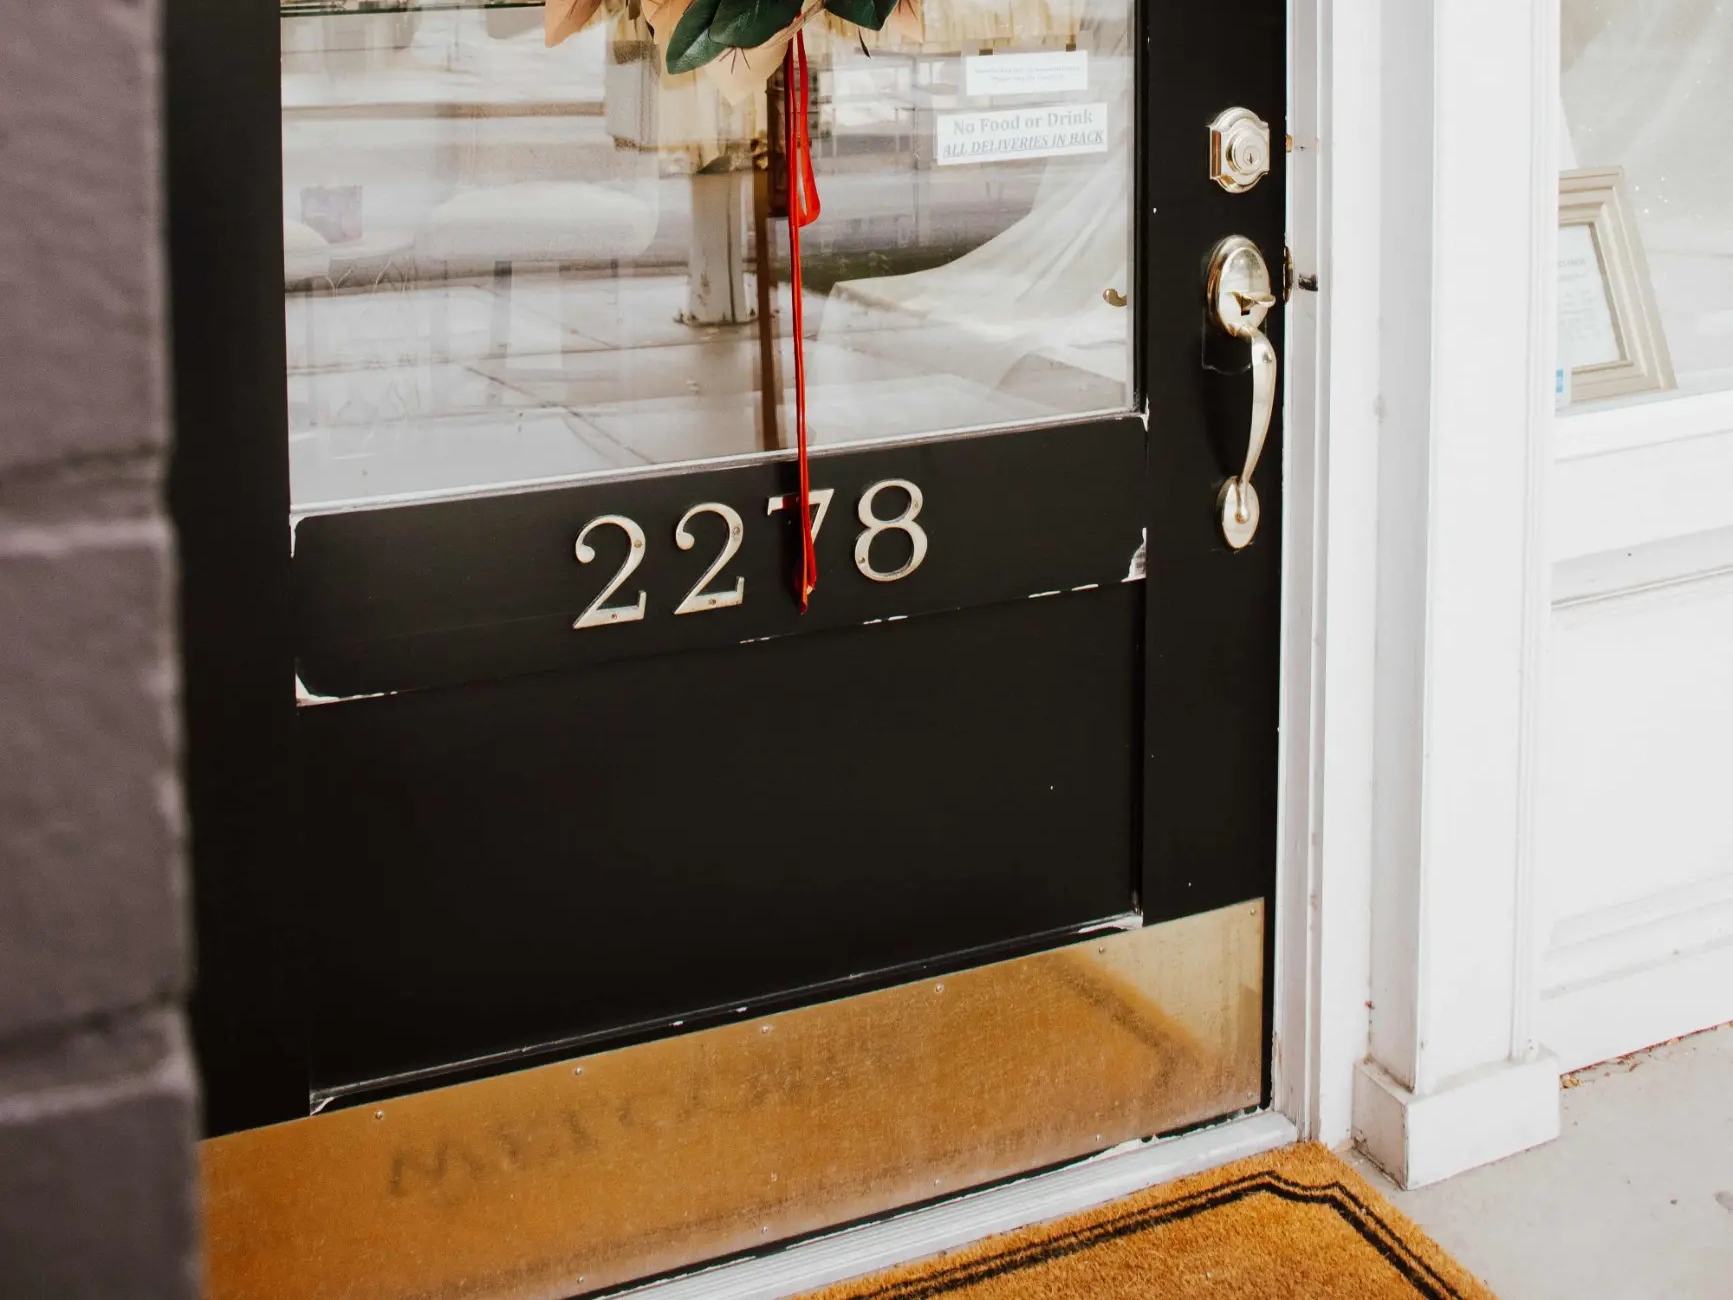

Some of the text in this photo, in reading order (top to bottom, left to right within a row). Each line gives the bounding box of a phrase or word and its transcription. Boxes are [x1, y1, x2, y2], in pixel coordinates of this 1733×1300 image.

[954, 109, 1093, 135] No Food or Drink
[943, 130, 1104, 157] ALL DELIVERIES IN BACK
[574, 478, 928, 629] 2278
